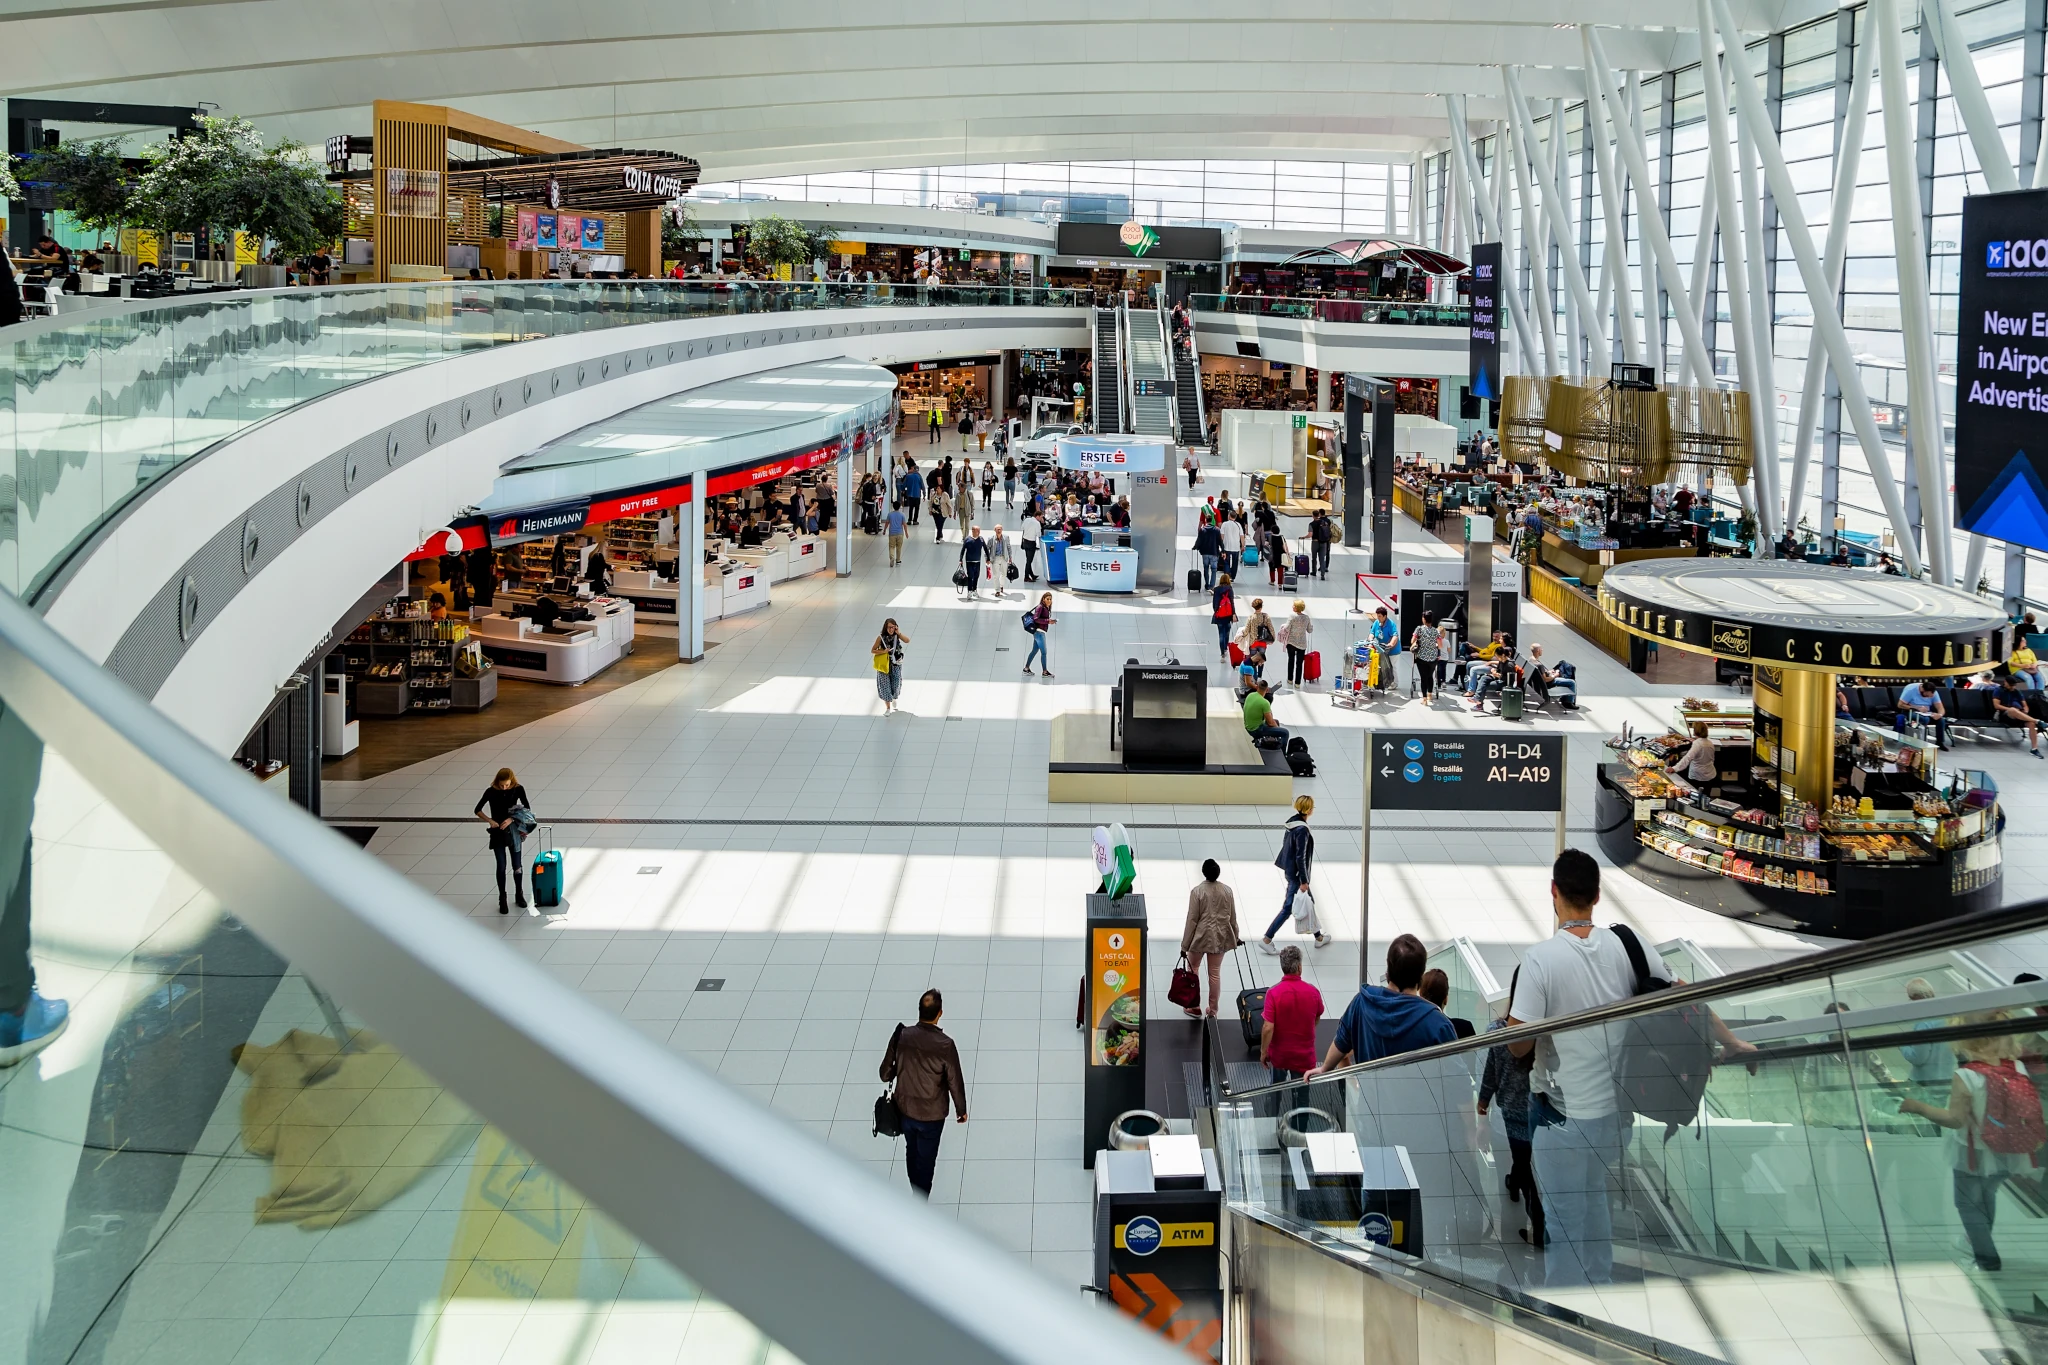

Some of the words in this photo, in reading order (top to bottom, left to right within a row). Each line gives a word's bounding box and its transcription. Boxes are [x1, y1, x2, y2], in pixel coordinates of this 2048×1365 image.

[326, 135, 348, 163] FFEE
[623, 165, 651, 193] COSTA
[653, 175, 682, 197] COFFEE
[390, 186, 437, 198] welcome
[1123, 224, 1140, 233] food
[1122, 232, 1142, 240] court
[1480, 264, 1493, 278] iaac
[1475, 296, 1485, 307] New
[1485, 296, 1493, 308] Era
[1474, 311, 1479, 322] in
[1479, 312, 1493, 326] Airport
[1984, 310, 2028, 336] New
[1472, 327, 1495, 345] Advertising
[1978, 345, 1995, 370] in
[1080, 451, 1113, 463] ERSTE
[752, 470, 769, 480] TRAVEL
[768, 465, 783, 477] VALUE
[1136, 476, 1159, 484] ERSTE
[522, 511, 583, 533] HEINEMANN
[620, 500, 641, 512] DUTY
[642, 497, 659, 508] FREE
[1080, 561, 1110, 572] ERSTE
[1141, 672, 1189, 680] Mercedes-Benz
[1433, 742, 1465, 750] Beszállás
[1443, 752, 1462, 760] gates
[1433, 765, 1463, 773] Beszállás
[1443, 775, 1462, 783] gates
[1171, 1230, 1204, 1240] ATM
